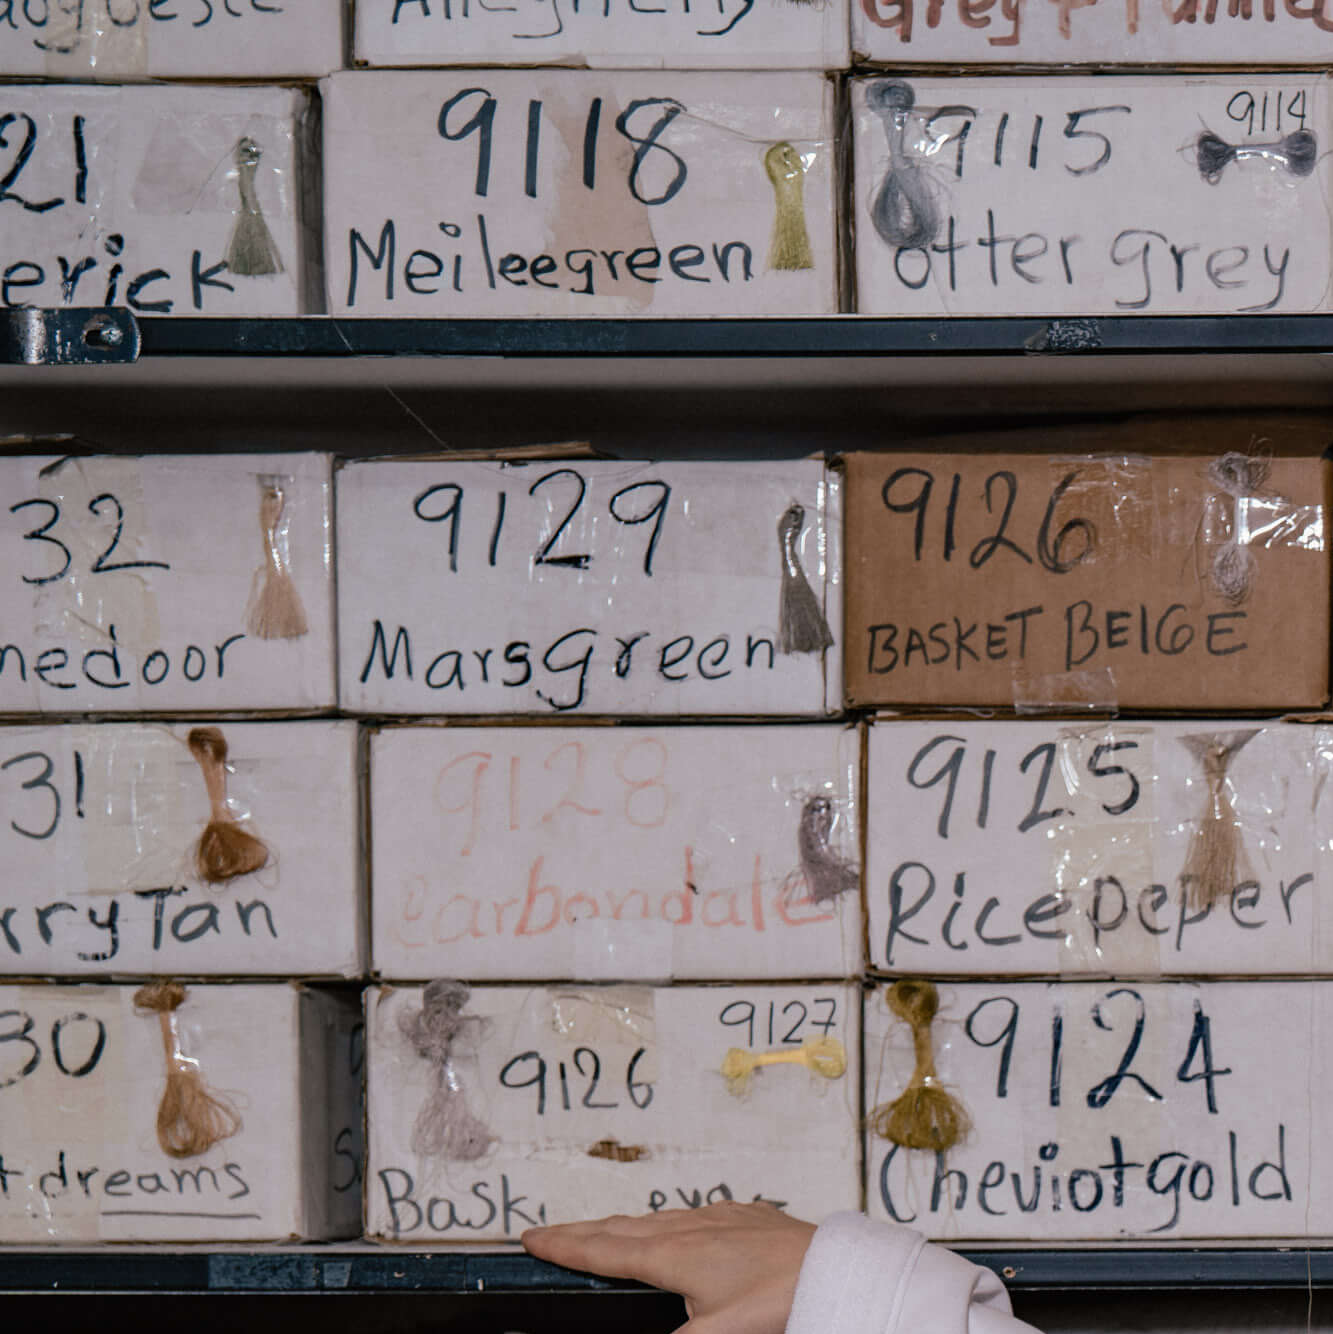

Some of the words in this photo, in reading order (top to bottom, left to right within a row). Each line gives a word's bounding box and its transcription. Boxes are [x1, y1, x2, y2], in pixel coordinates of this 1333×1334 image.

[437, 87, 690, 206] 9118
[922, 103, 1131, 177] 9115
[1226, 89, 1309, 136] 9114
[348, 212, 753, 306] Meileegreen
[413, 469, 673, 577] 9129
[881, 467, 1096, 574] 9126
[359, 618, 778, 710] Marsgreen
[867, 606, 1044, 675] BASKET
[1065, 600, 1249, 671] BEIGE
[1, 750, 85, 839] 31
[432, 736, 671, 857] 9128
[906, 734, 1141, 839] 9125
[719, 998, 837, 1049] 9127
[964, 988, 1232, 1115] 9124
[500, 1045, 655, 1116] 9126
[39, 1151, 251, 1201] dreams
[879, 1123, 1292, 1234] Cheviotgold
